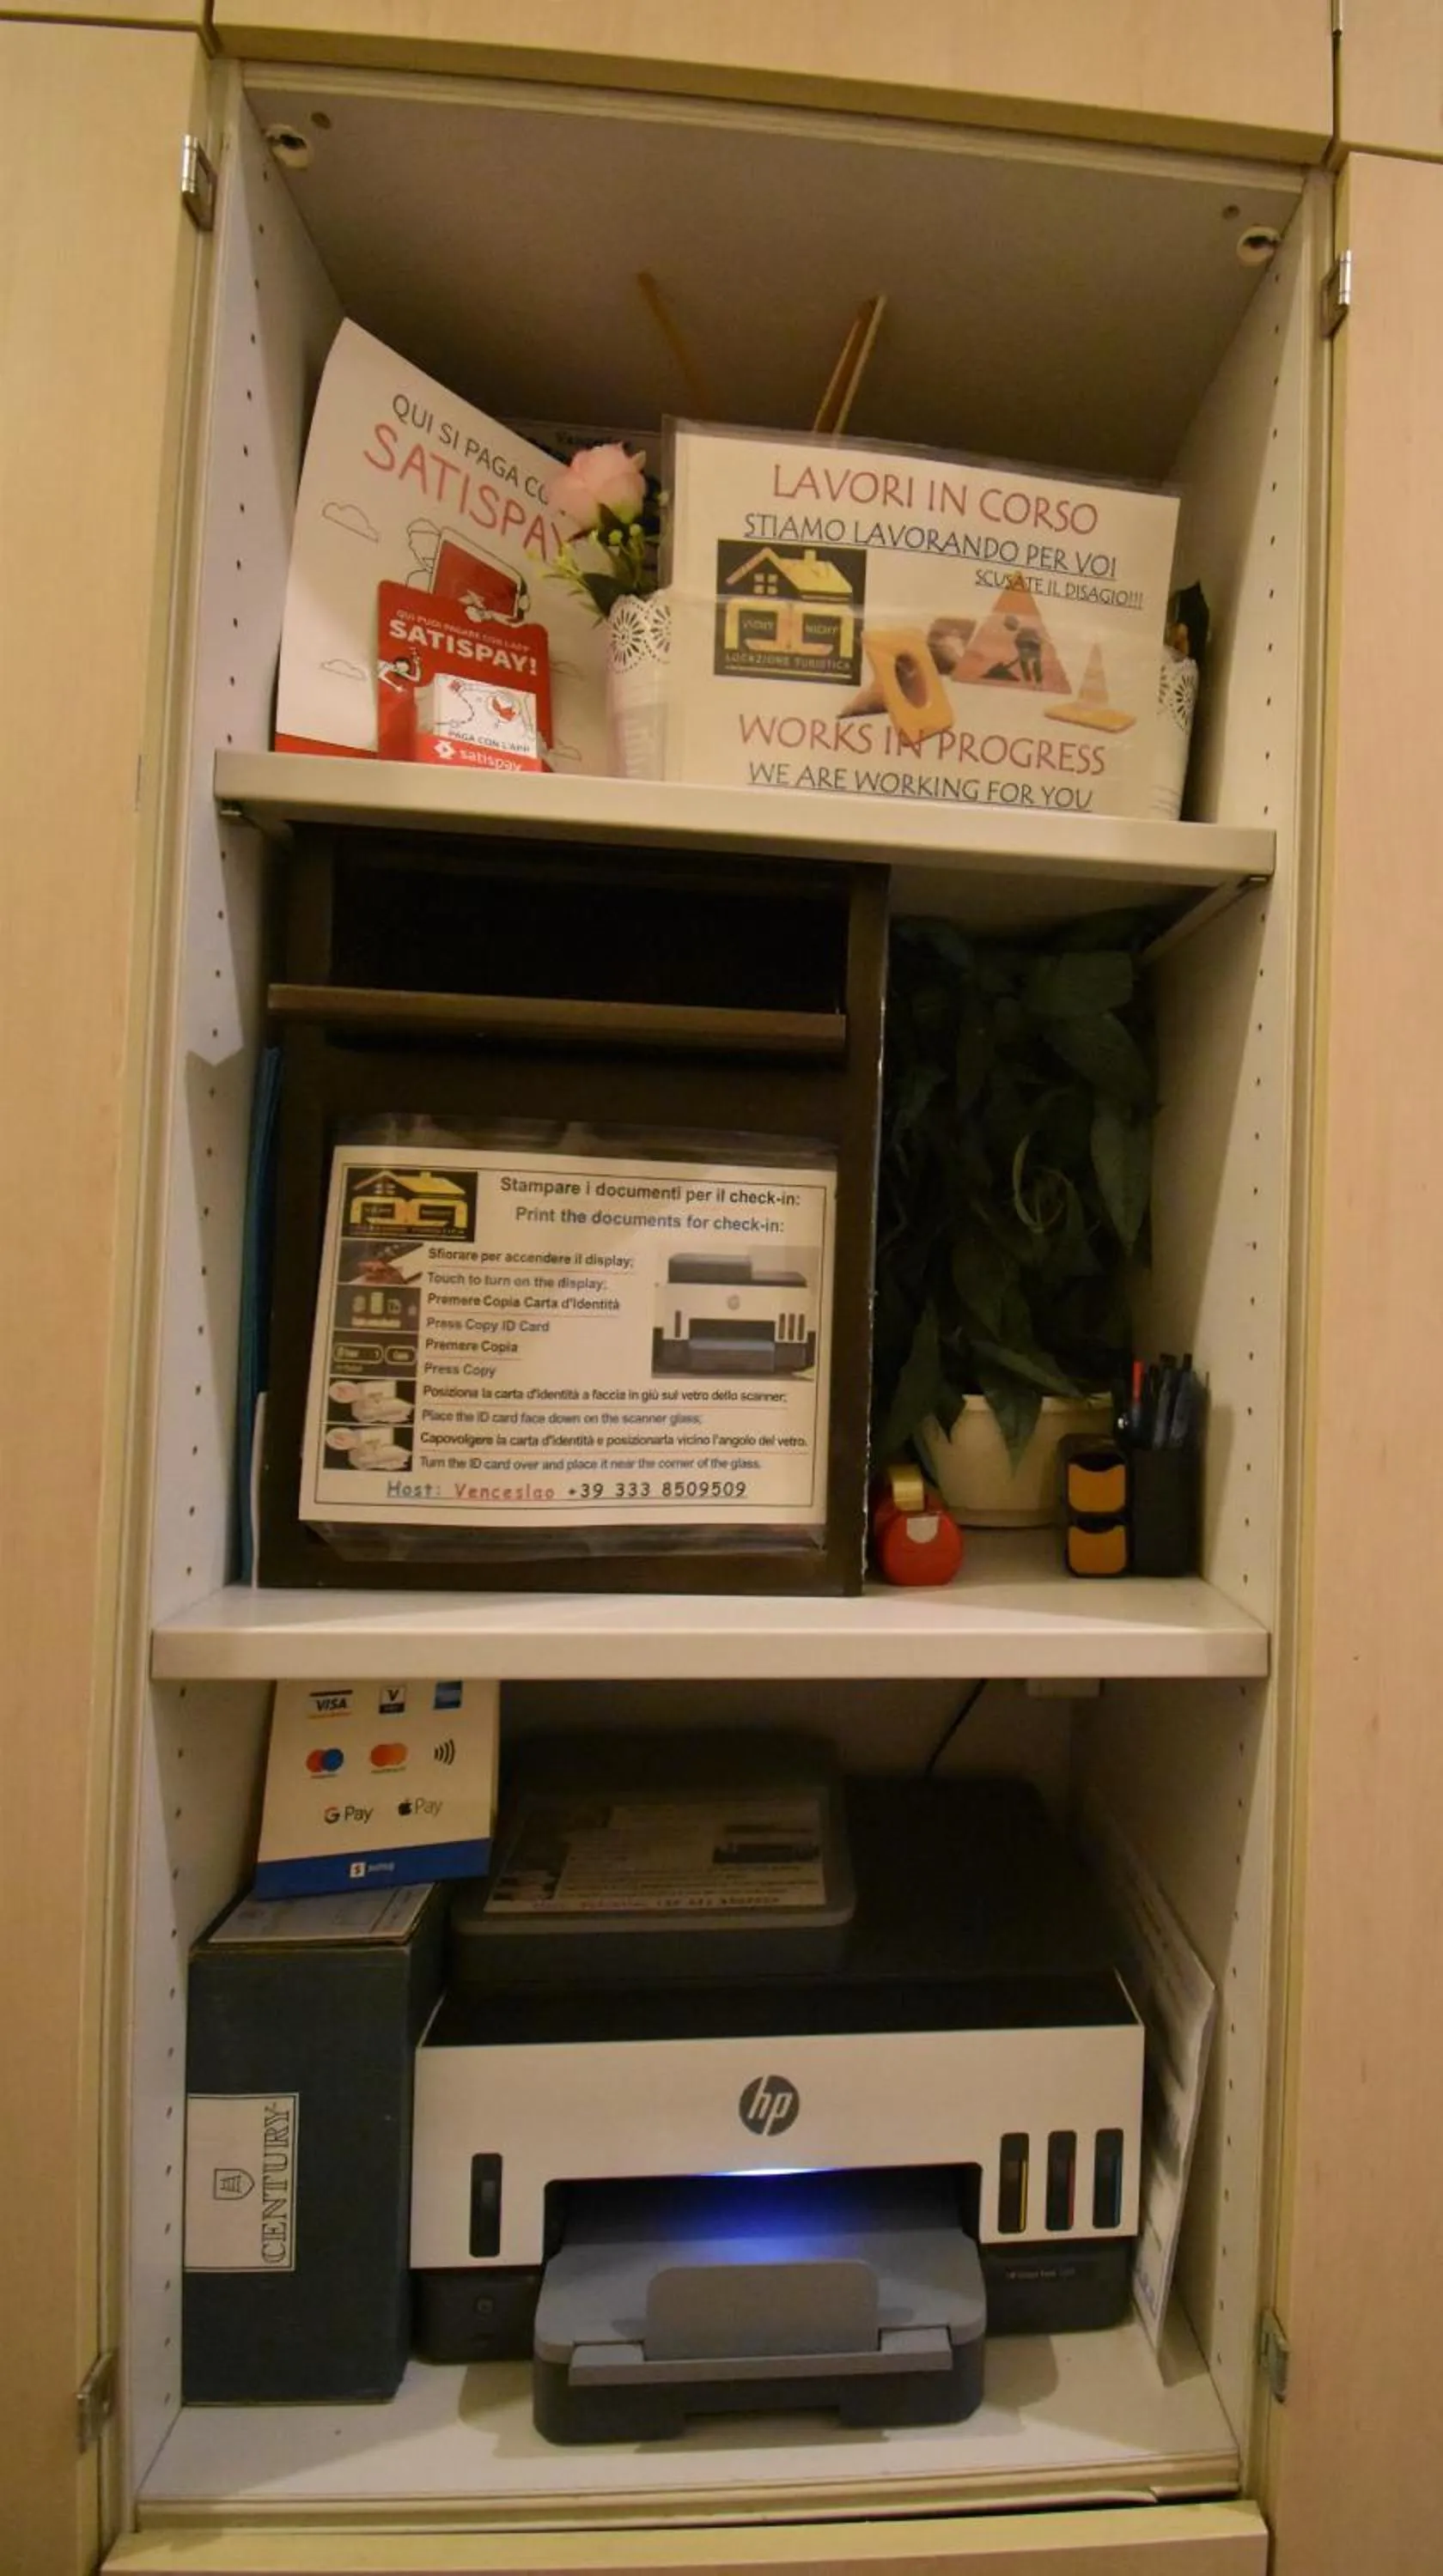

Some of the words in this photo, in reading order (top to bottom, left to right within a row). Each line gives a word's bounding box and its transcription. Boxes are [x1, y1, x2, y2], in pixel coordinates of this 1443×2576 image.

[393, 393, 434, 434] QUI
[439, 422, 460, 450] SI
[464, 438, 519, 488] PAGA
[774, 464, 914, 508] LAVORI
[928, 480, 967, 517] IN
[979, 489, 1099, 535] CORSO
[744, 513, 845, 542] STIAMO
[854, 520, 1020, 562] LAVORANDO
[1026, 543, 1069, 572] PER
[1075, 550, 1117, 578] VOI
[976, 568, 1044, 593] SCUSATE
[1047, 580, 1061, 598] IL
[1065, 582, 1144, 609] DISAGIO!!!
[389, 618, 538, 677] SATISPAY!
[739, 714, 874, 755] WORKS
[885, 726, 923, 759] IN
[938, 727, 1106, 775] PROGRESS
[460, 750, 523, 771] satispay
[749, 761, 790, 784] WE
[795, 764, 847, 789] ARE
[855, 769, 981, 801] WORKING
[988, 781, 1034, 805] FOR
[1041, 786, 1093, 811] YOU
[500, 1176, 581, 1197] Stampare
[595, 1182, 683, 1201] documenti
[685, 1189, 712, 1205] per
[715, 1188, 726, 1203] il
[729, 1190, 801, 1206] check-in:
[515, 1206, 556, 1223] Print
[561, 1208, 587, 1224] the
[592, 1209, 681, 1228] documents
[686, 1214, 710, 1229] for
[714, 1216, 785, 1233] check-in:
[428, 1248, 478, 1261] Sfiorare
[480, 1252, 502, 1263] per
[504, 1252, 571, 1265] accendere
[574, 1253, 582, 1264] il
[585, 1254, 634, 1268] display;
[427, 1272, 465, 1285] Touch
[468, 1273, 482, 1285] to
[484, 1274, 511, 1286] turn
[514, 1278, 530, 1286] on
[533, 1276, 554, 1287] the
[427, 1292, 482, 1306] Premere
[483, 1295, 521, 1309] Copia
[524, 1296, 558, 1309] Carta
[426, 1316, 462, 1329] Press
[465, 1318, 499, 1332] Copy
[502, 1320, 516, 1331] ID
[519, 1320, 551, 1332] Card
[425, 1339, 479, 1352] Premere
[481, 1340, 519, 1354] Copia
[423, 1362, 460, 1375] Press
[463, 1363, 496, 1378] Copy
[423, 1385, 478, 1399] Posiziona
[482, 1388, 492, 1399] la
[495, 1388, 524, 1400] carta
[527, 1388, 580, 1400] d'identità
[581, 1391, 590, 1400] a
[592, 1389, 626, 1400] faccia
[628, 1389, 639, 1400] in
[642, 1388, 659, 1404] giù
[661, 1389, 679, 1400] sul
[681, 1390, 709, 1401] vetro
[711, 1389, 738, 1401] dello
[422, 1408, 454, 1421] Place
[455, 1410, 475, 1422] the
[477, 1411, 490, 1423] ID
[492, 1413, 518, 1424] card
[521, 1413, 546, 1424] face
[548, 1413, 581, 1424] down
[583, 1415, 599, 1425] on
[600, 1413, 619, 1424] the
[622, 1414, 667, 1425] scanner
[420, 1431, 494, 1448] Capovolgere
[496, 1434, 507, 1445] la
[509, 1436, 539, 1447] carta
[542, 1435, 594, 1446] d'identità
[606, 1435, 674, 1448] posizionarla
[676, 1434, 710, 1445] vicino
[712, 1434, 757, 1448] l'angolo
[758, 1435, 775, 1446] del
[419, 1456, 445, 1468] Turn
[448, 1457, 466, 1469] the
[470, 1457, 482, 1469] ID
[484, 1459, 510, 1470] card
[513, 1461, 539, 1471] over
[542, 1459, 564, 1470] and
[566, 1459, 598, 1473] place
[600, 1459, 608, 1469] it
[611, 1461, 635, 1469] near
[638, 1457, 655, 1469] the
[658, 1460, 694, 1469] corner
[697, 1458, 709, 1469] of
[710, 1458, 728, 1469] the
[387, 1479, 441, 1498] Host:
[454, 1483, 555, 1500] Venceslao
[568, 1482, 604, 1498] +39
[615, 1481, 651, 1498] 333
[661, 1481, 746, 1498] 8509509
[316, 1698, 348, 1711] VISA
[387, 1688, 399, 1702] V
[344, 1805, 374, 1825] Pay
[415, 1796, 443, 1818] Pay
[744, 2074, 796, 2136] hp
[261, 2101, 289, 2264] CENTURY
